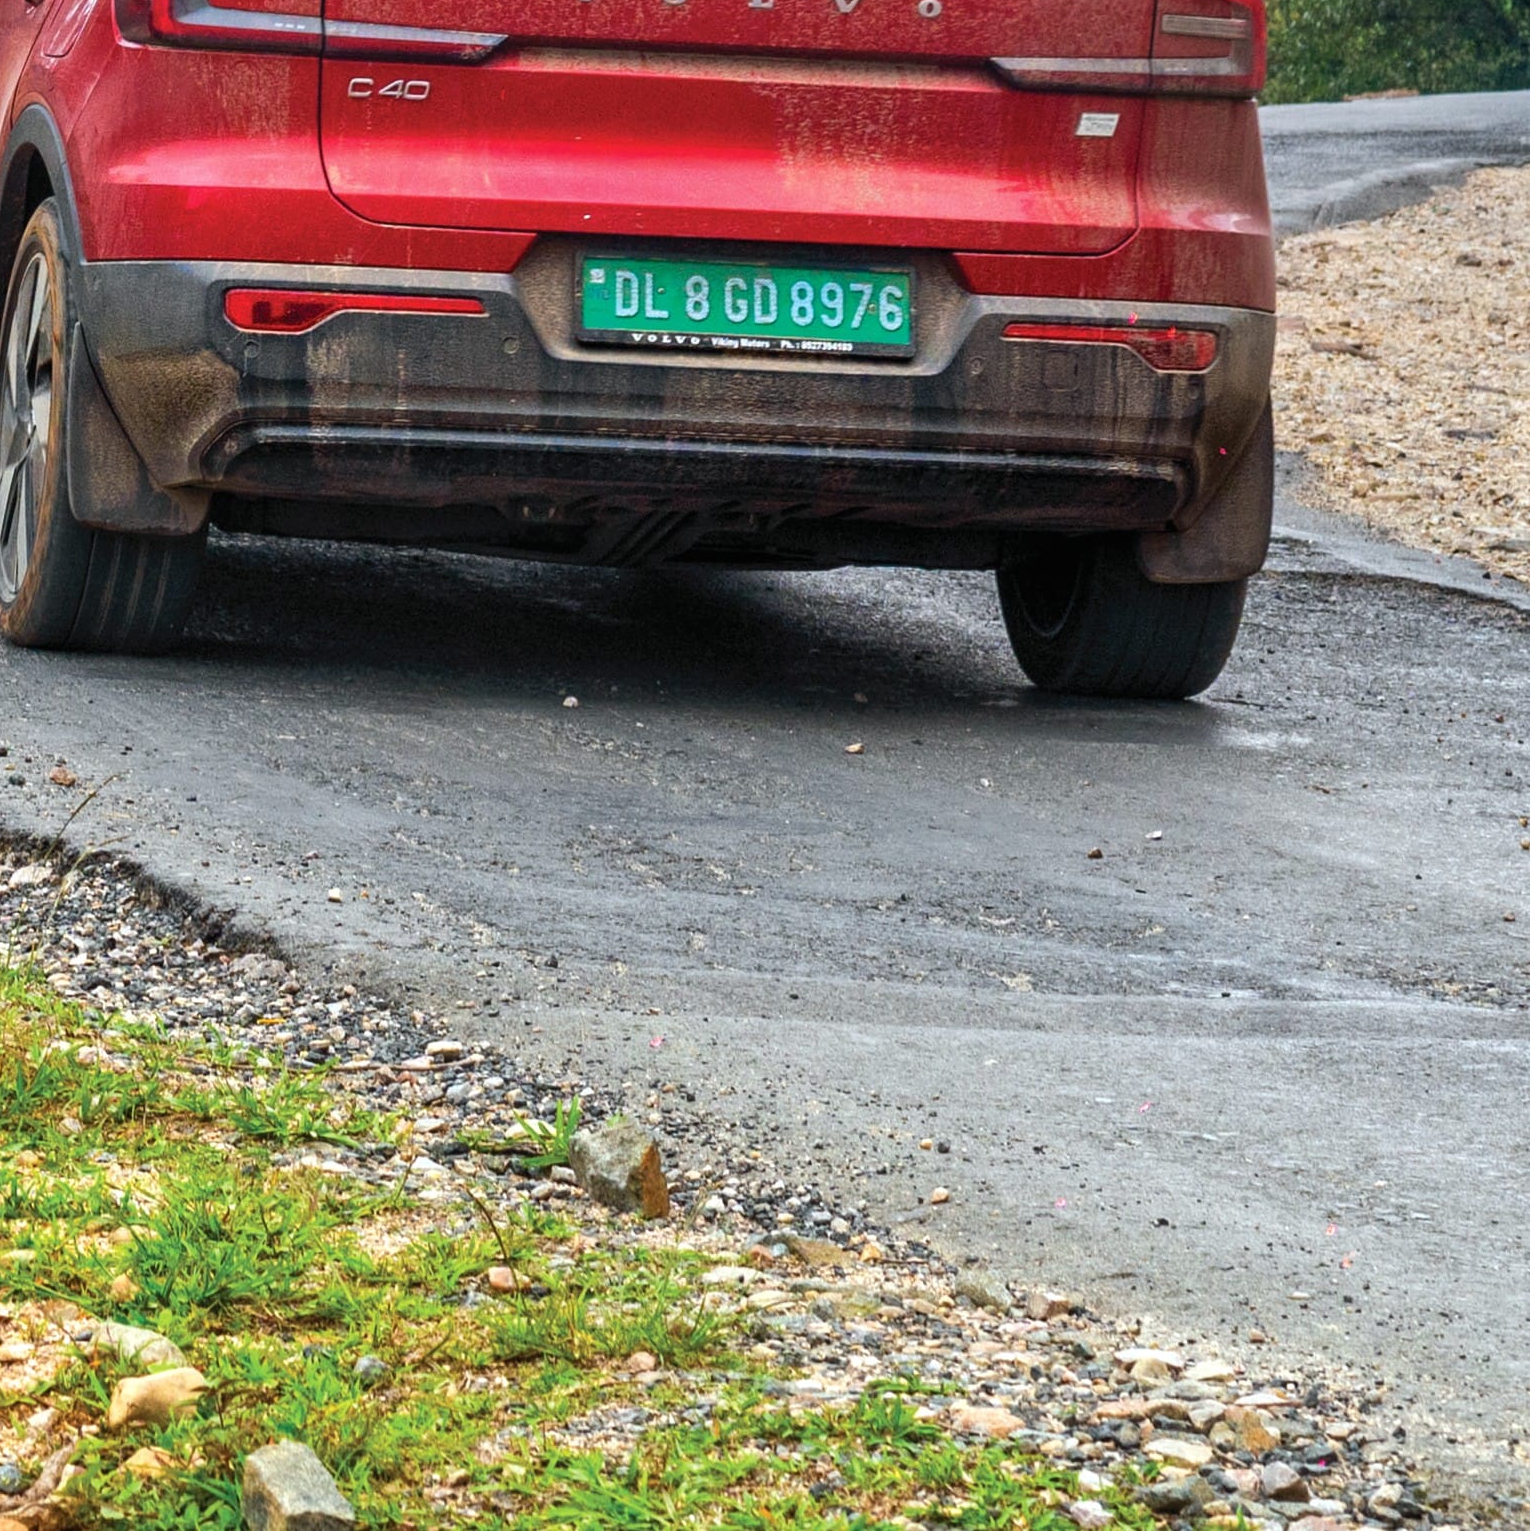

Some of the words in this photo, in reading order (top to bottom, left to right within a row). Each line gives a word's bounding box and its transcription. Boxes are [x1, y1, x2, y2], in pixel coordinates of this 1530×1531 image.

[347, 77, 431, 101] C40
[615, 269, 669, 319] DL
[684, 274, 710, 320] 8
[723, 277, 779, 325] GD
[789, 280, 904, 331] 8976
[631, 333, 701, 345] VOLVO
